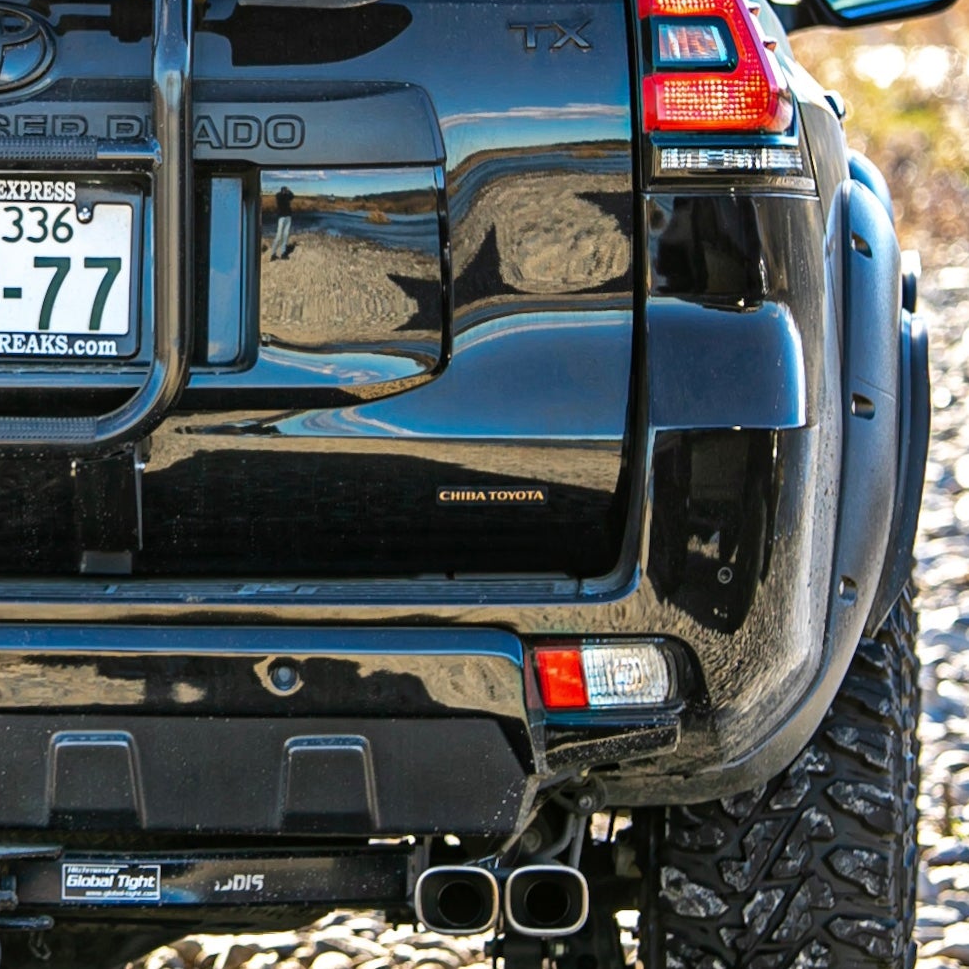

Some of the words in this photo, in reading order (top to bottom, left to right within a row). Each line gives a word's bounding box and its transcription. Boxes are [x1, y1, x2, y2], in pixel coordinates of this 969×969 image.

[508, 19, 592, 49] TX
[106, 114, 305, 149] PADO
[1, 206, 74, 244] 336
[438, 490, 487, 501] CHIBA
[488, 490, 544, 501] TOYOTA
[66, 874, 115, 888] Global
[117, 874, 156, 890] Tight
